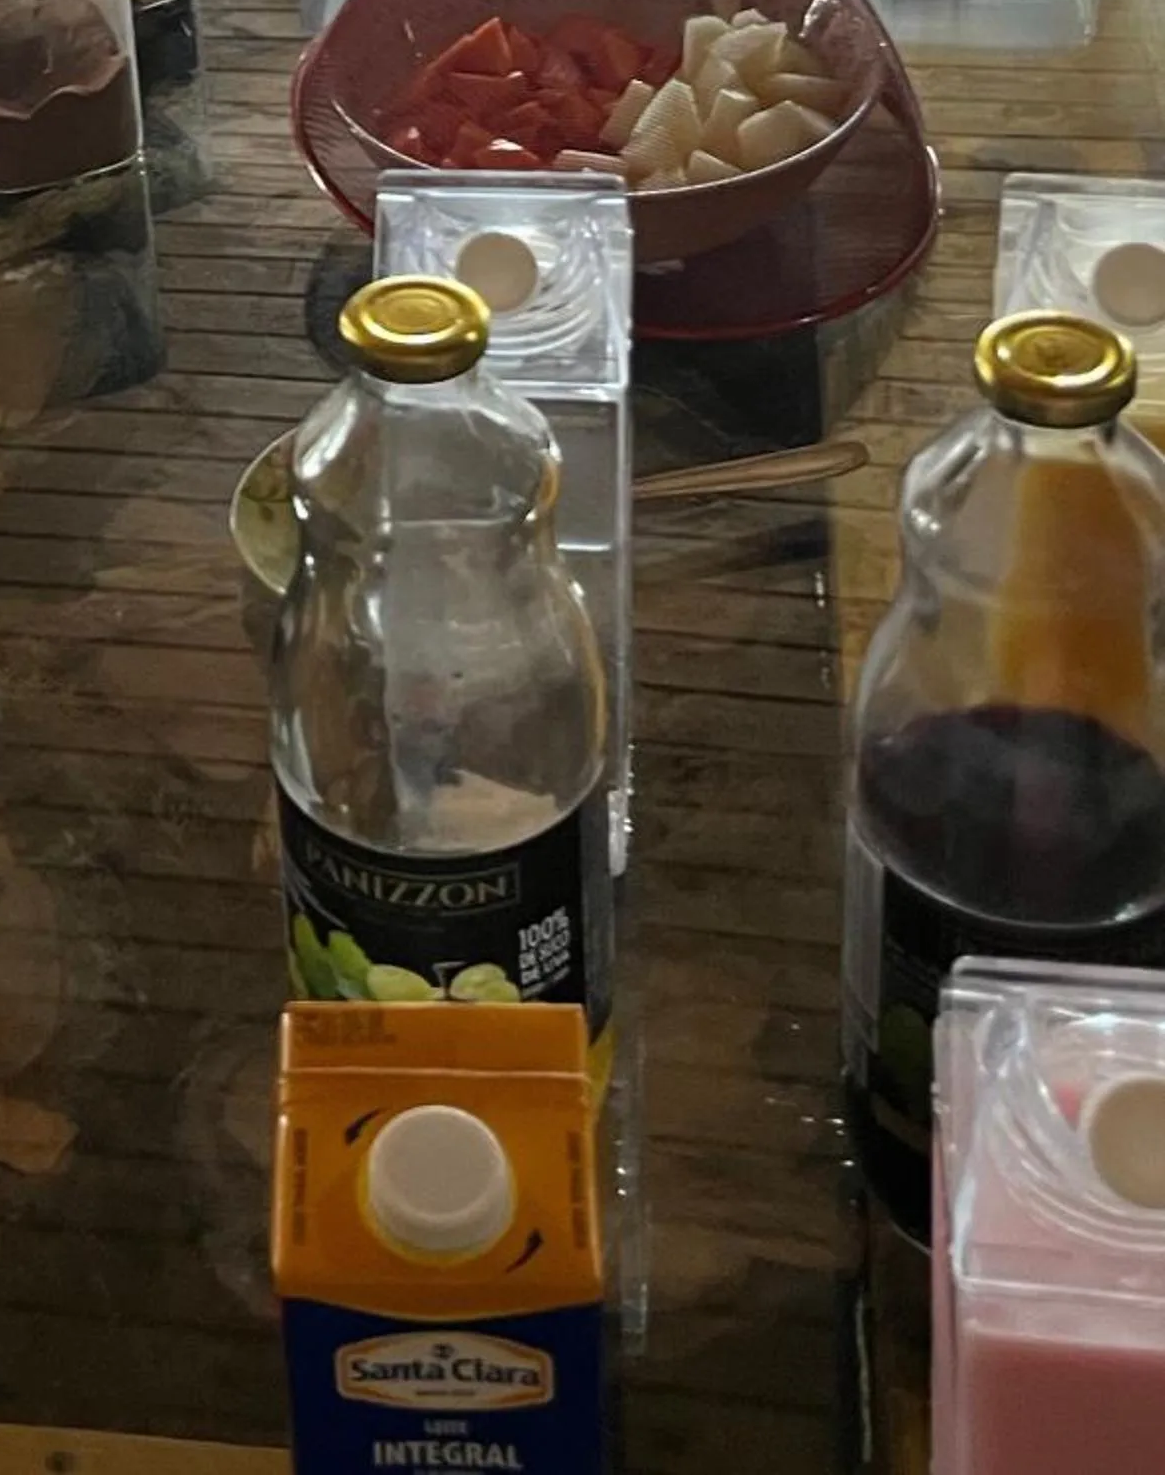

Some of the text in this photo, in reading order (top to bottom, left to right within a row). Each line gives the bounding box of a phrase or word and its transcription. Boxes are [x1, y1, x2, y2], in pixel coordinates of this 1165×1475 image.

[305, 841, 506, 908] PANIZZON
[518, 906, 569, 951] 100%
[351, 1358, 540, 1387] Santa Clara
[373, 1440, 525, 1469] INTEGRAL
